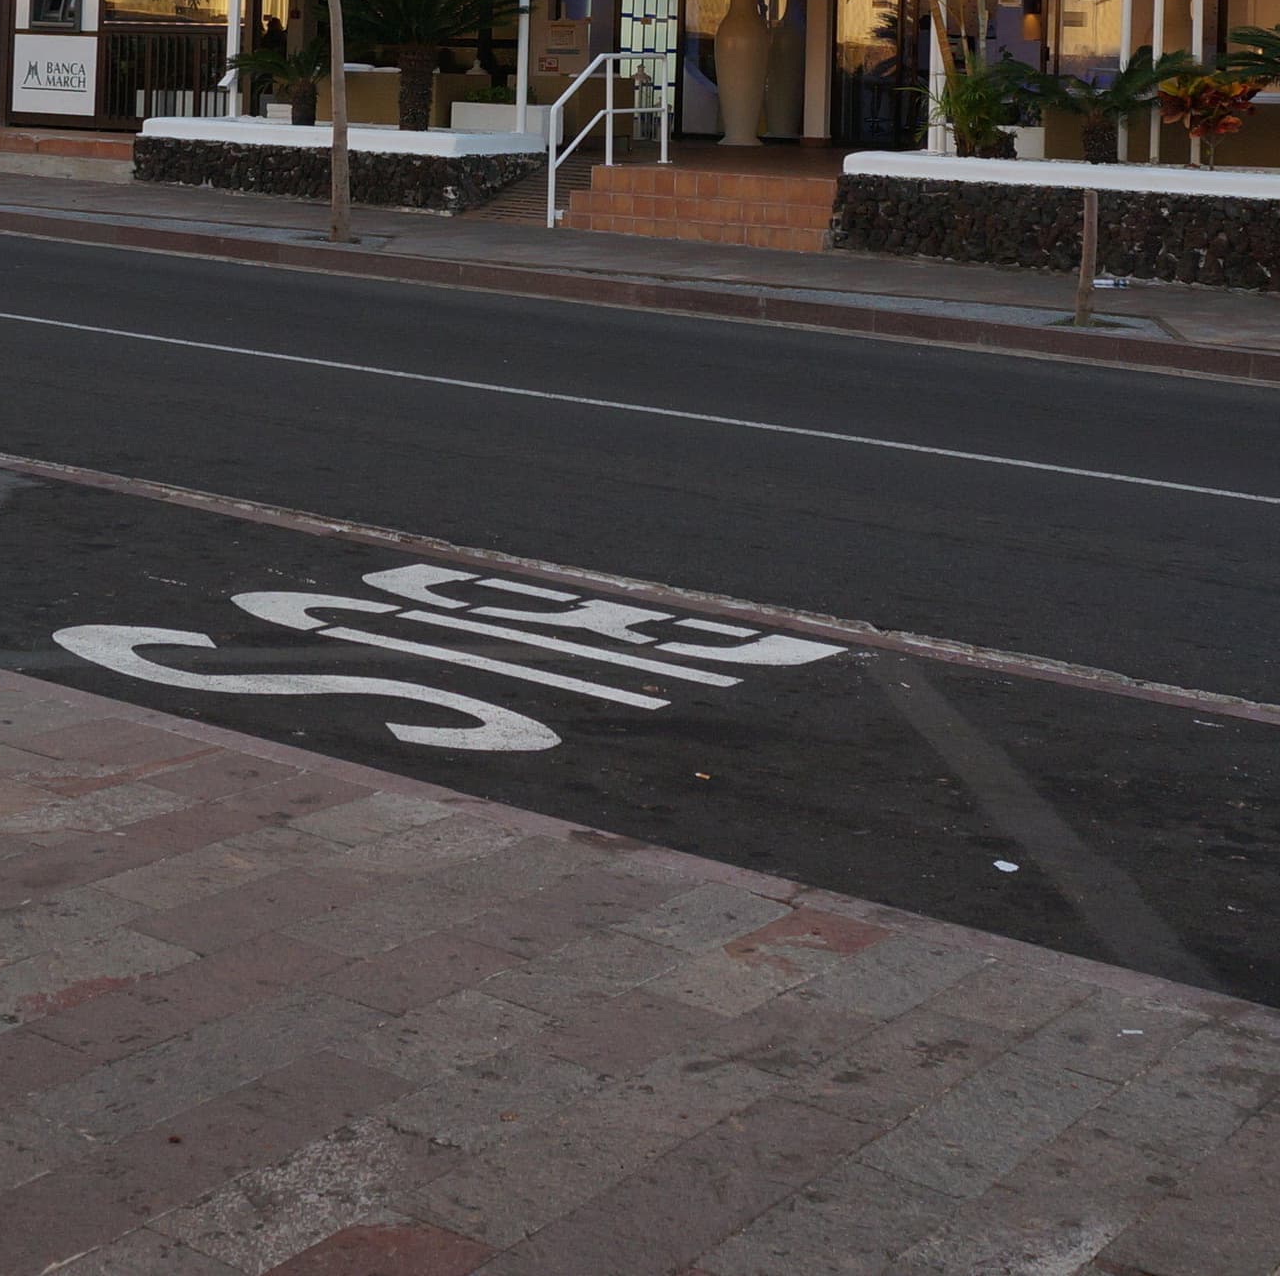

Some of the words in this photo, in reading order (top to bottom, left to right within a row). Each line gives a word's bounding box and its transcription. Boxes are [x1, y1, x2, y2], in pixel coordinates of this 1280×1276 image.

[46, 62, 86, 75] BANCA
[45, 76, 87, 88] MARCH
[53, 563, 848, 751] BUS
